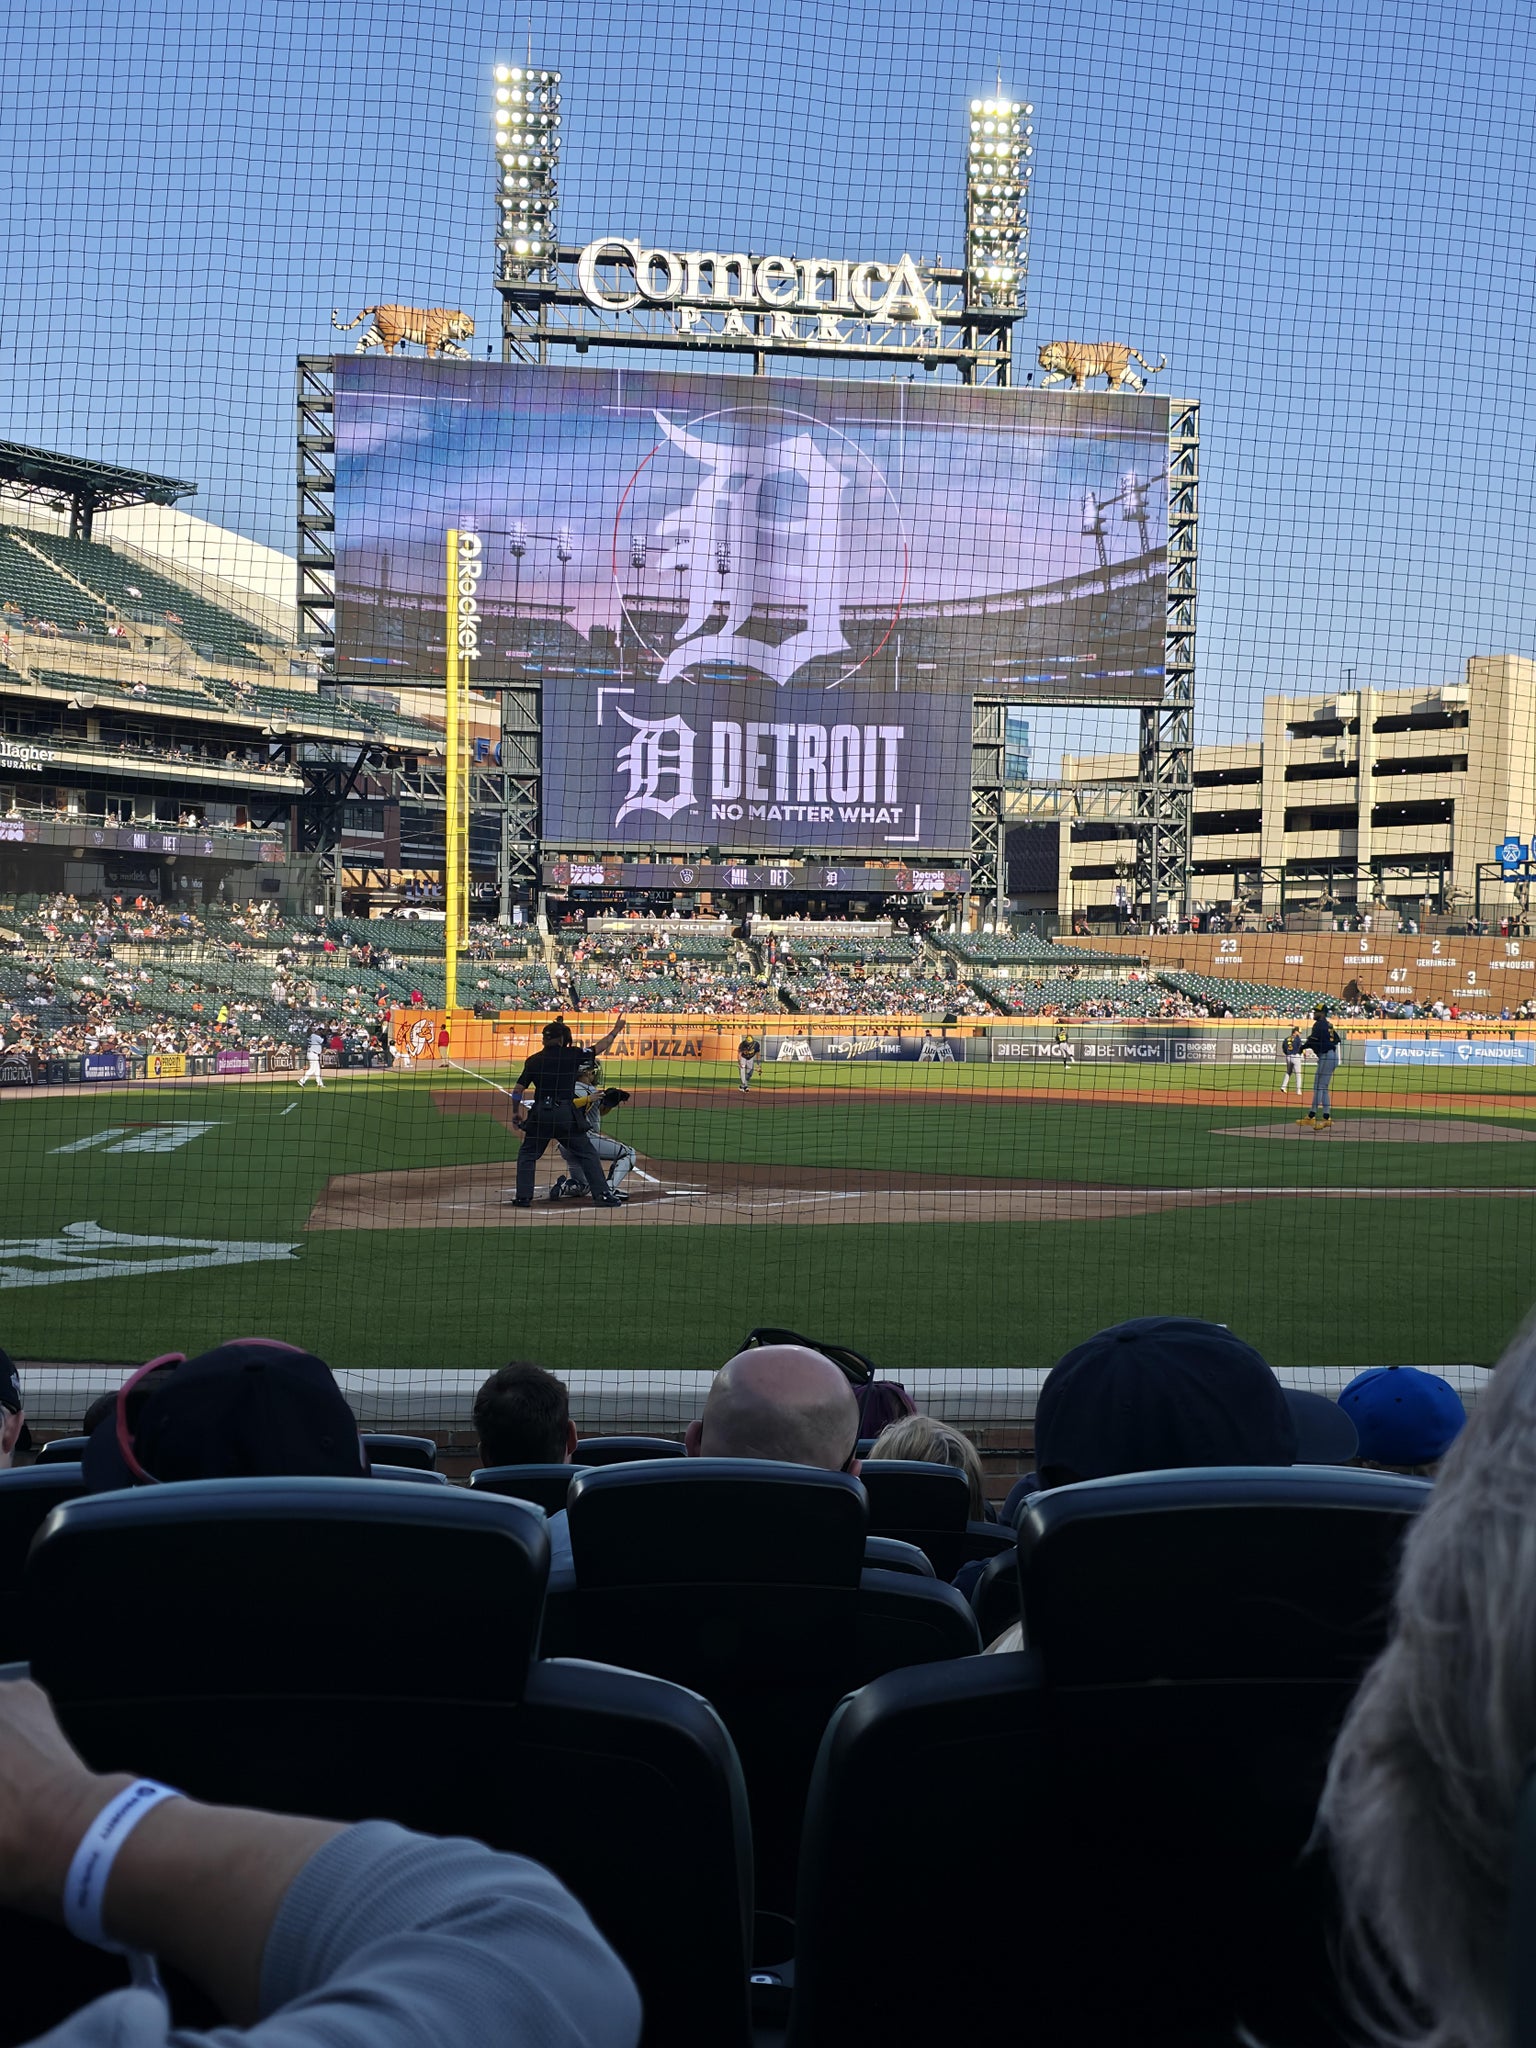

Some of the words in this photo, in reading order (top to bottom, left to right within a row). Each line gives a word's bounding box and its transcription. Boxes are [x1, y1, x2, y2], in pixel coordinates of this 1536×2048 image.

[677, 307, 844, 342] PARK
[458, 560, 482, 660] Rocket
[711, 721, 905, 804] DETROIT
[711, 804, 744, 821] NO
[748, 804, 834, 823] MATTER
[838, 806, 904, 824] WHAT
[570, 863, 604, 873] Detroit
[912, 870, 945, 880] Detroit
[731, 867, 749, 886] MIL
[770, 869, 787, 886] DET
[640, 923, 727, 932] CHEVROLET
[1220, 939, 1237, 953] 23
[1360, 939, 1369, 951] 5
[1431, 941, 1441, 954] 2
[1504, 942, 1520, 956] 16
[1389, 968, 1408, 982] 47
[1466, 971, 1476, 985] 3
[640, 1039, 703, 1057] PIZZA!
[841, 1038, 887, 1060] Miller
[1099, 1044, 1161, 1057] BETMGM
[1187, 1042, 1217, 1051] BIGGBY
[1232, 1043, 1277, 1054] BIGGBY
[1395, 1048, 1445, 1058] FANDUEL
[1474, 1048, 1525, 1058] FANDUEL
